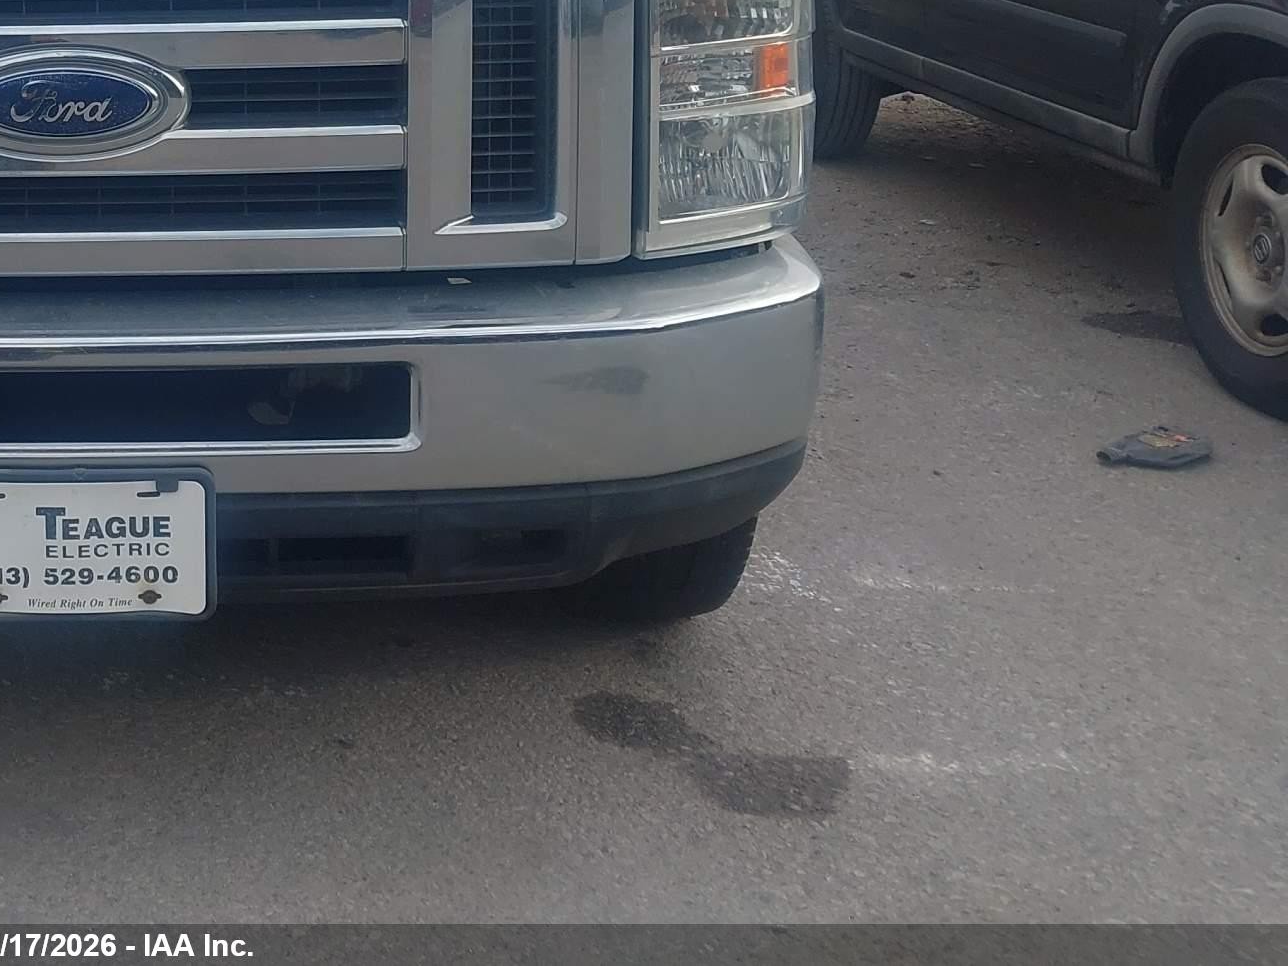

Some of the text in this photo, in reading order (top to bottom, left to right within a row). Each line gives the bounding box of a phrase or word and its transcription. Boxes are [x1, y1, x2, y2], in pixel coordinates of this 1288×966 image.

[11, 79, 112, 122] Ford
[45, 542, 170, 559] ELECTRIC
[43, 566, 179, 586] 529-4600
[28, 597, 133, 610] Wired Right On Time
